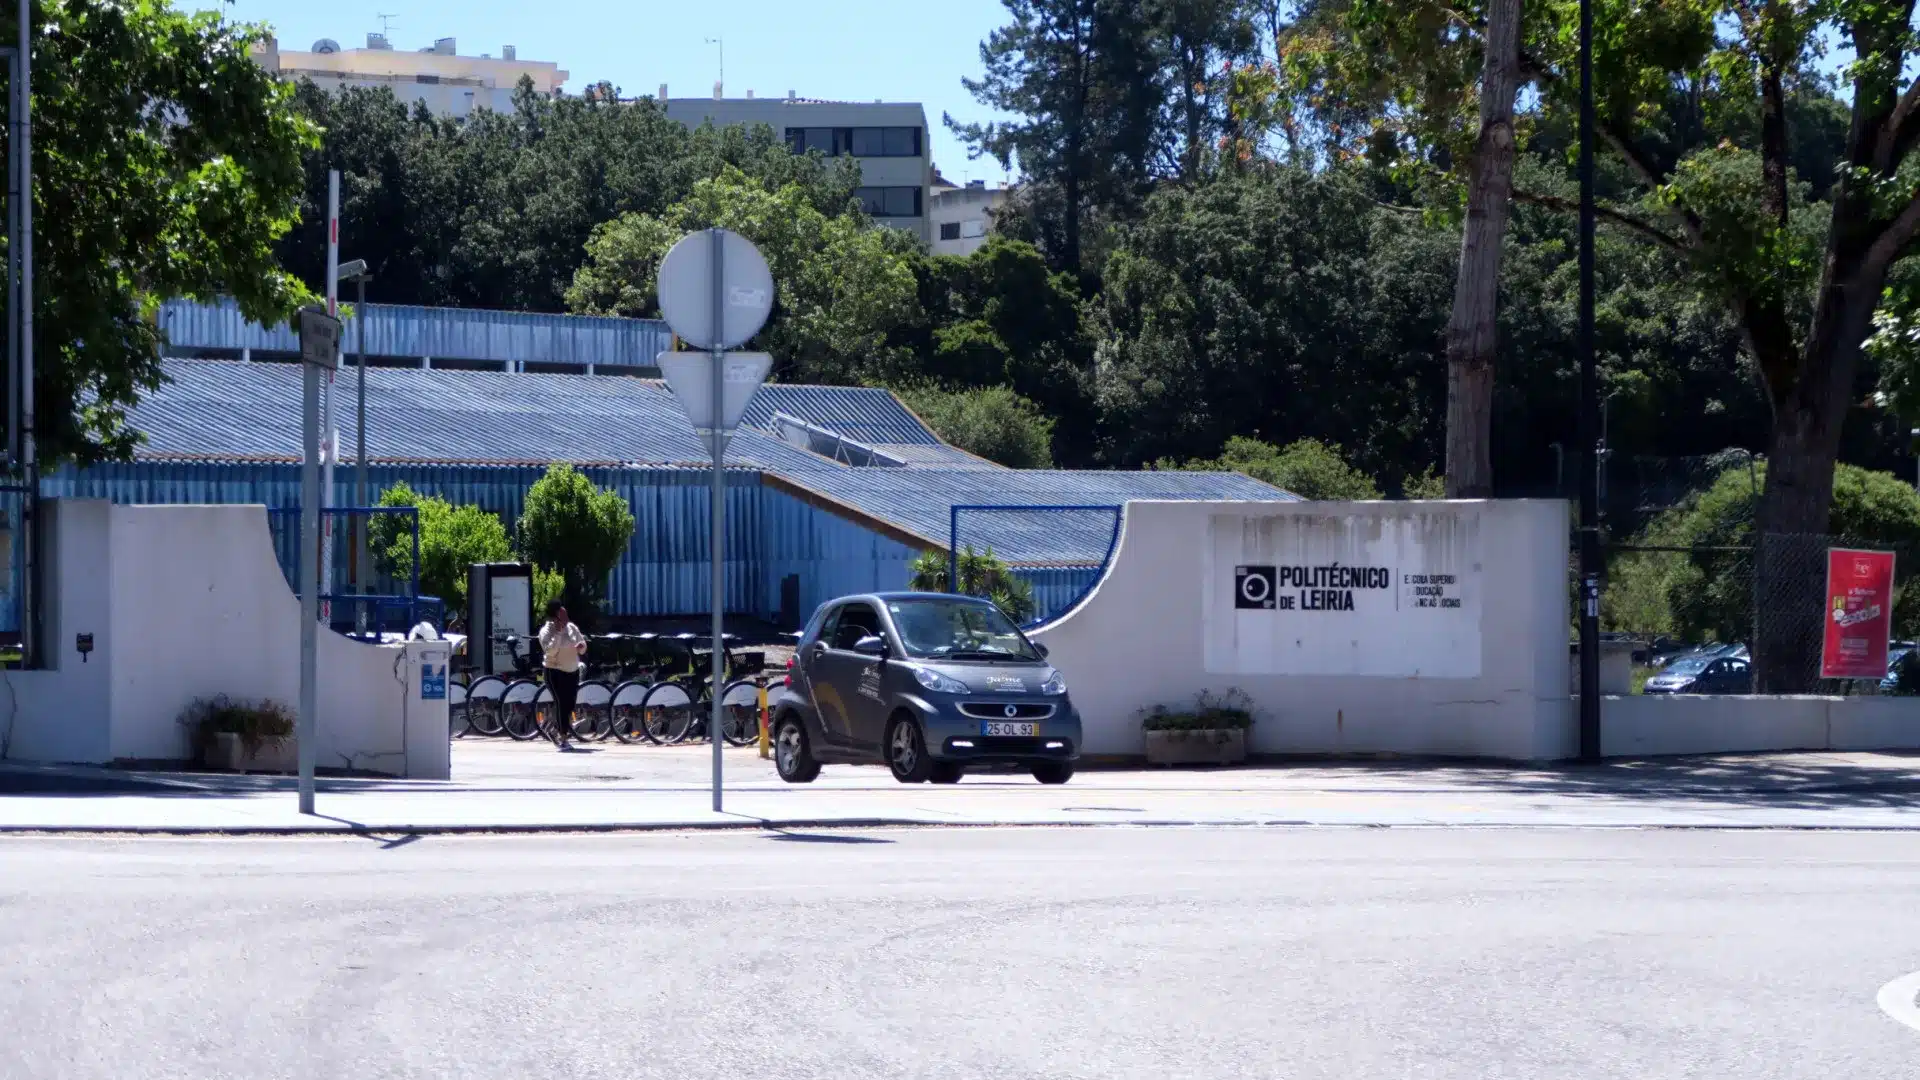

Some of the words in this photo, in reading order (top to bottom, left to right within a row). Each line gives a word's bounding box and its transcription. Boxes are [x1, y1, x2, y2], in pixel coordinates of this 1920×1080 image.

[1280, 562, 1389, 589] POLITÉCNICO
[1280, 596, 1295, 610] DE
[1301, 590, 1354, 611] LEIRIA
